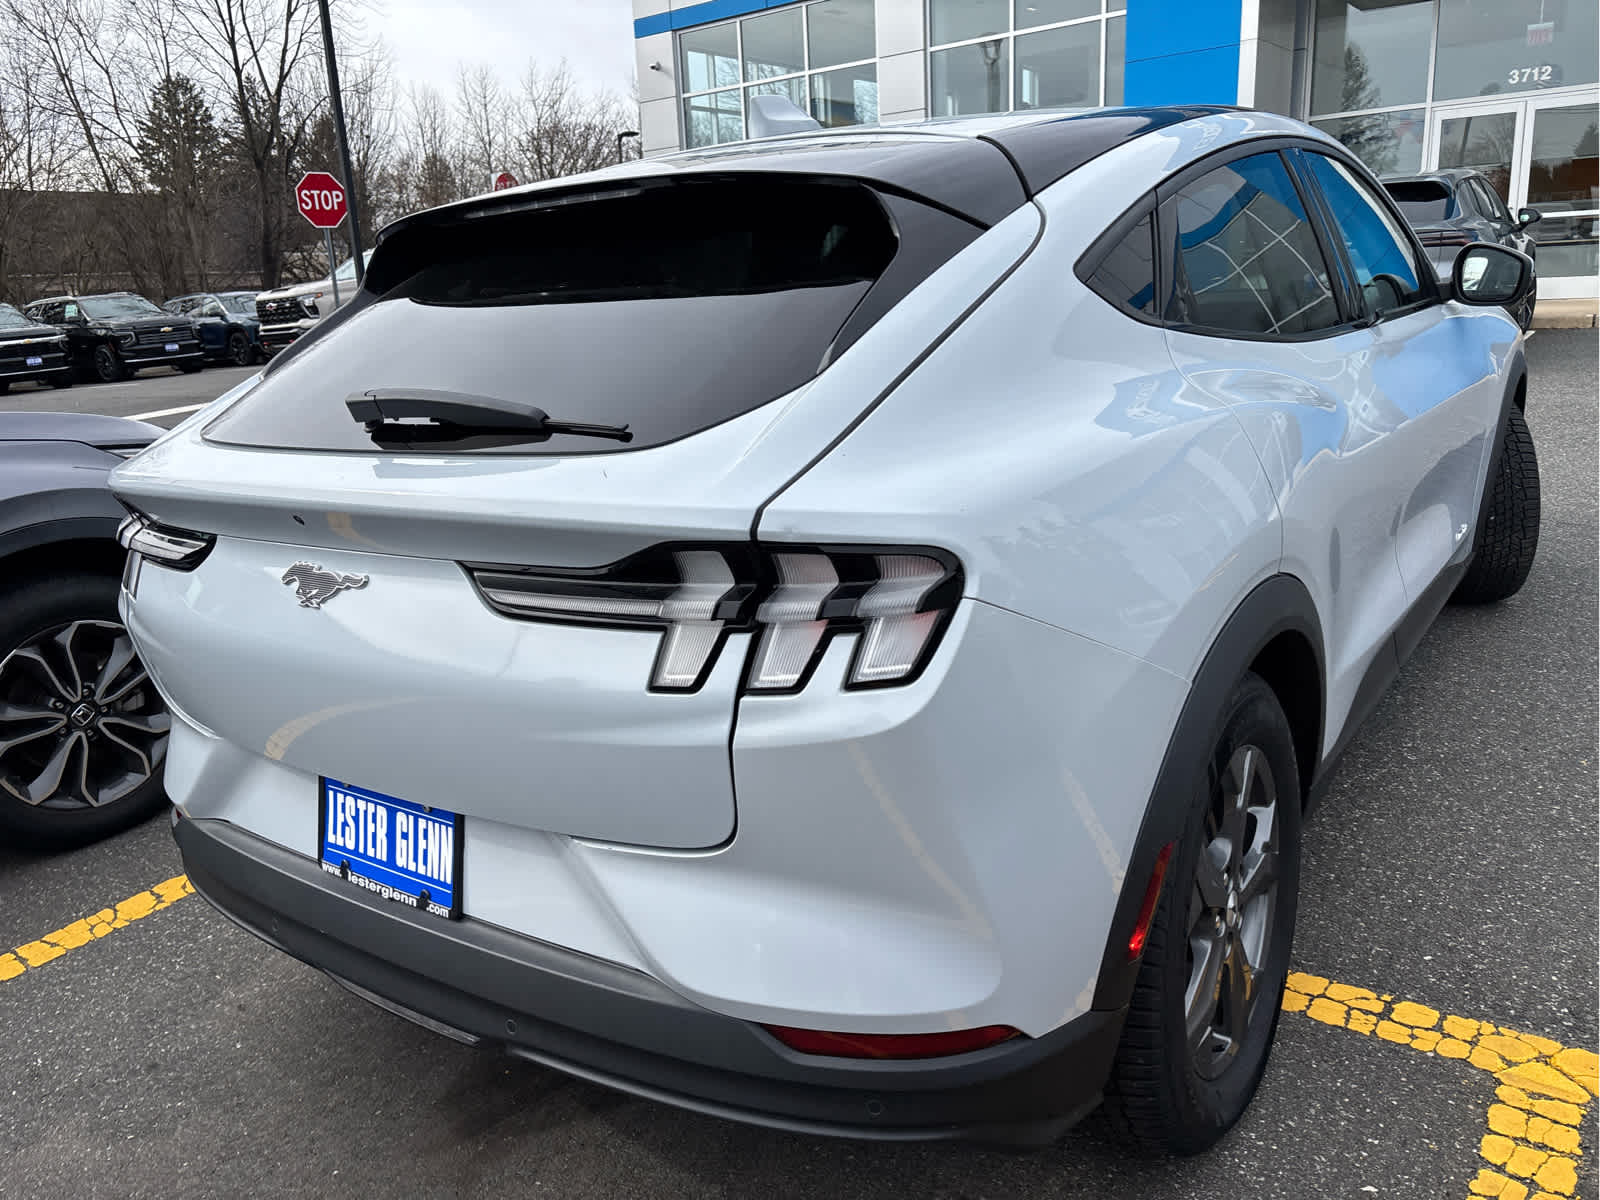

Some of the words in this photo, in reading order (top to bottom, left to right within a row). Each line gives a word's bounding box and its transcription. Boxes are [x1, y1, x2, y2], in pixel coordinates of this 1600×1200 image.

[1508, 65, 1552, 84] 3712
[300, 189, 344, 210] STOP
[327, 789, 388, 862] LESTER
[396, 811, 453, 885] GLENN
